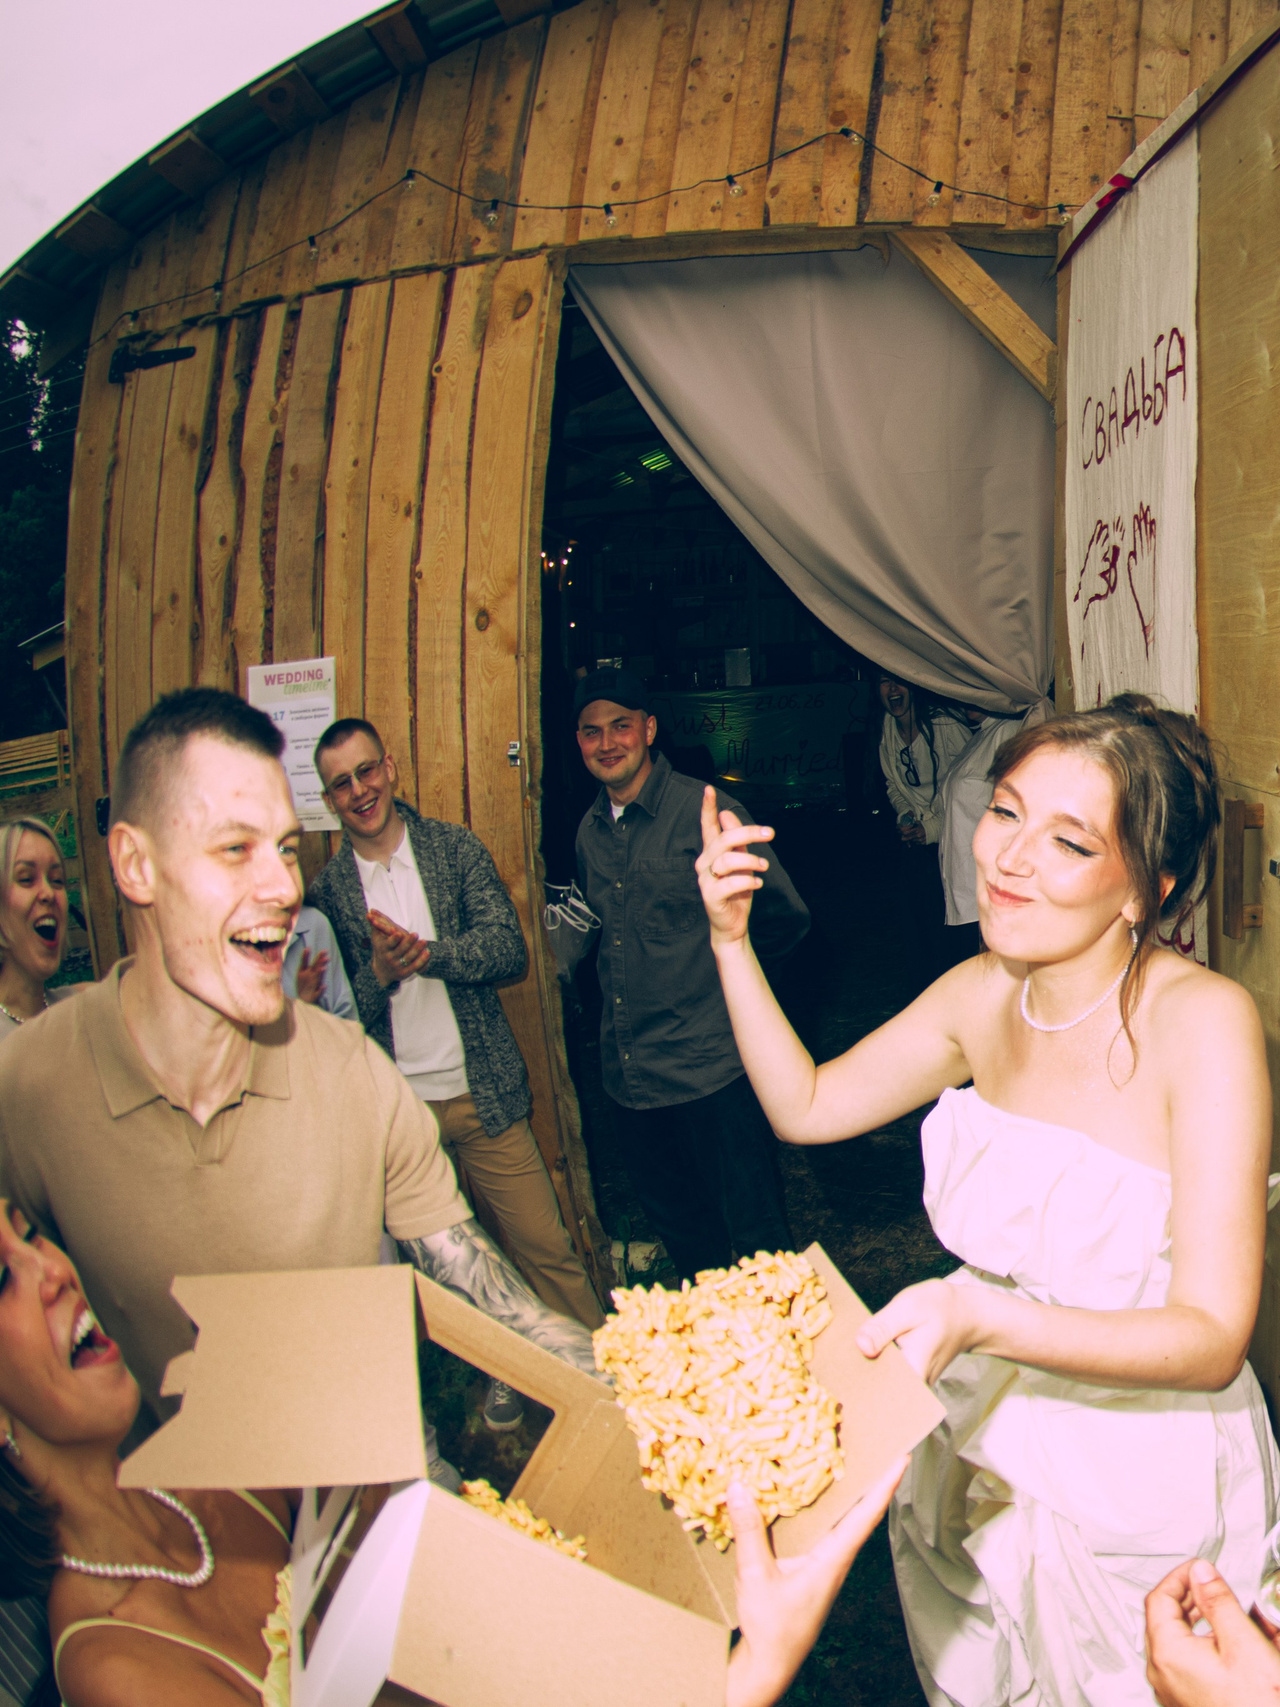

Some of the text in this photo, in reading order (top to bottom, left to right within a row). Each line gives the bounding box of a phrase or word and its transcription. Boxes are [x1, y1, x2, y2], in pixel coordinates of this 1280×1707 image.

[1081, 327, 1187, 470] СВАДЬБА
[264, 669, 323, 686] WEDDING
[283, 679, 329, 696] timeline
[648, 697, 733, 736] Just
[718, 739, 845, 777] Married
